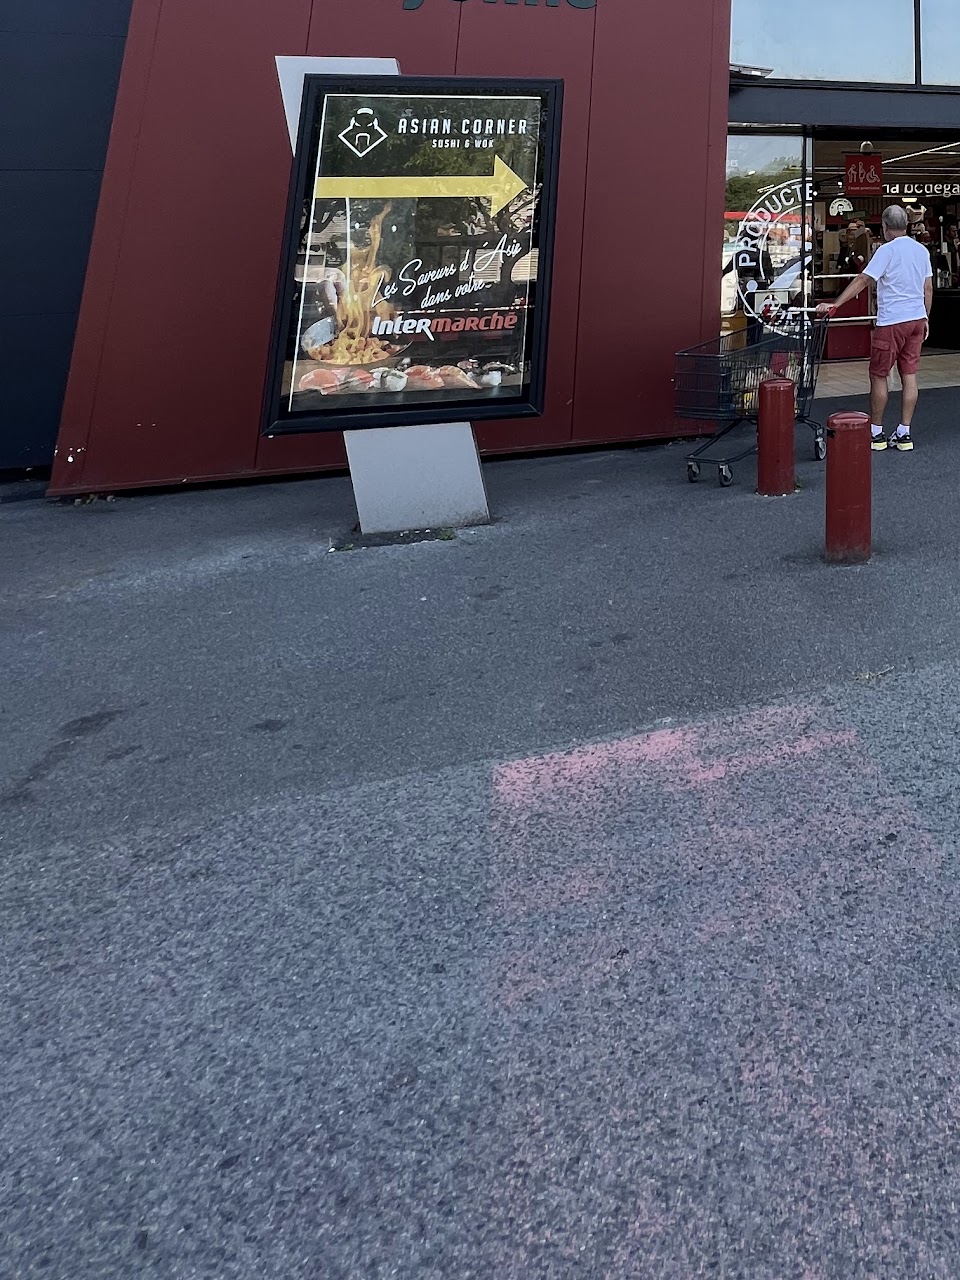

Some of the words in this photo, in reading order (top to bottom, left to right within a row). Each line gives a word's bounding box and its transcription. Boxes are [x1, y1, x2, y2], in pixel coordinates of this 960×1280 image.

[397, 118, 452, 135] ASIAN
[460, 118, 528, 135] CORNER
[431, 138, 461, 148] SUSHI
[474, 139, 494, 148] WOK
[371, 271, 399, 308] Les
[398, 258, 457, 296] Saveurs
[420, 285, 453, 309] dans
[454, 271, 491, 298] votre
[371, 311, 518, 342] Intermarché
